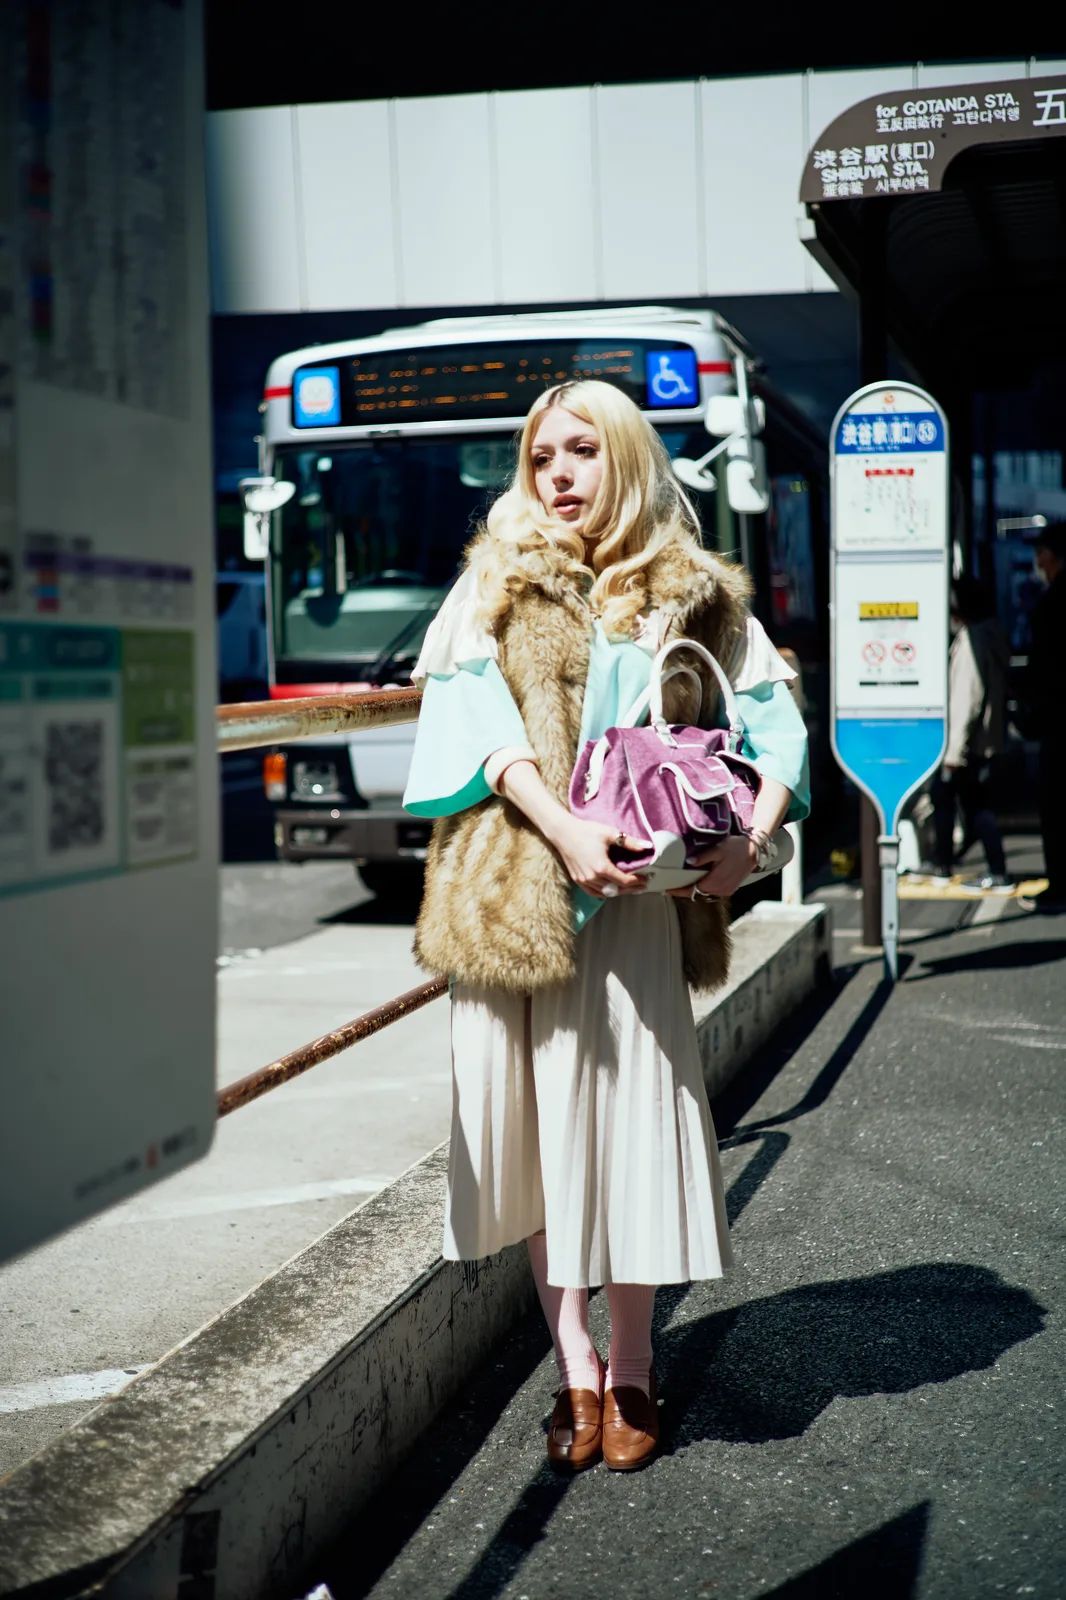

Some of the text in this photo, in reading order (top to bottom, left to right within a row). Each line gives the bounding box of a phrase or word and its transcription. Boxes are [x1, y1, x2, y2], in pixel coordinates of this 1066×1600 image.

[875, 92, 1020, 119] for GOTANDA STA.
[1033, 89, 1066, 127] 五
[821, 160, 928, 183] SHIBUYA STA.
